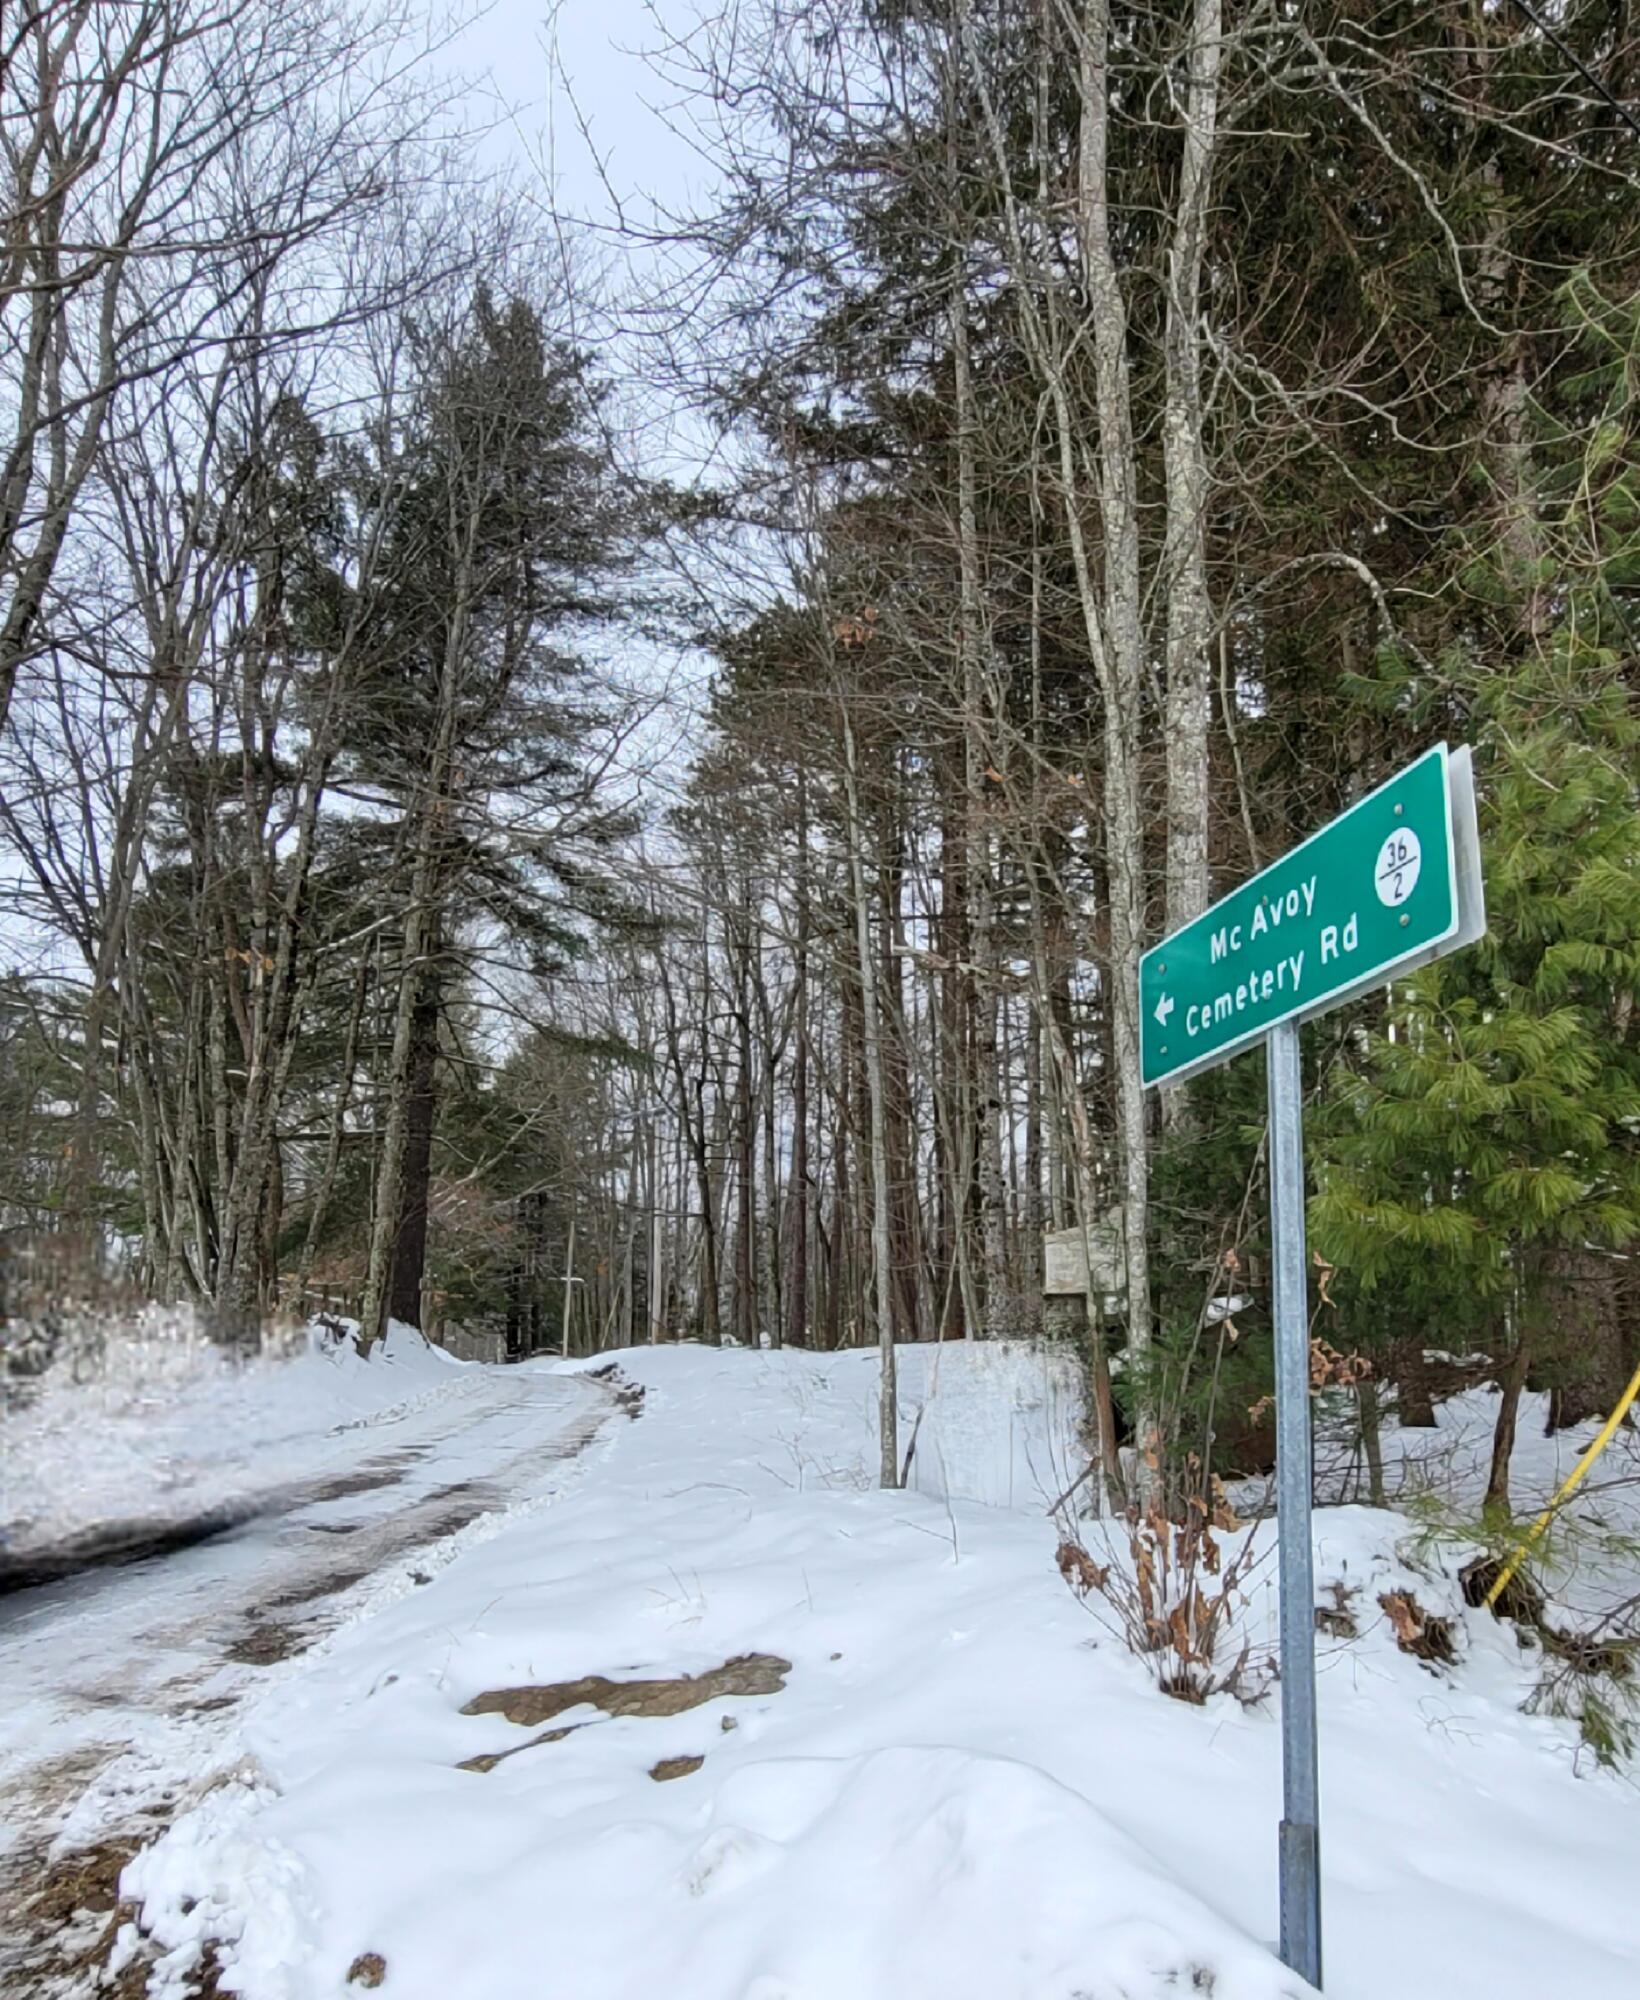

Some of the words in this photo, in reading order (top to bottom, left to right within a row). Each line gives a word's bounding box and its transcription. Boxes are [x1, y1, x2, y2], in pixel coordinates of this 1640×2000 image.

[1387, 836, 1408, 868] 36
[1393, 872, 1403, 900] 2
[1186, 950, 1304, 1037] Cemetery
[1320, 912, 1359, 965] Rd
